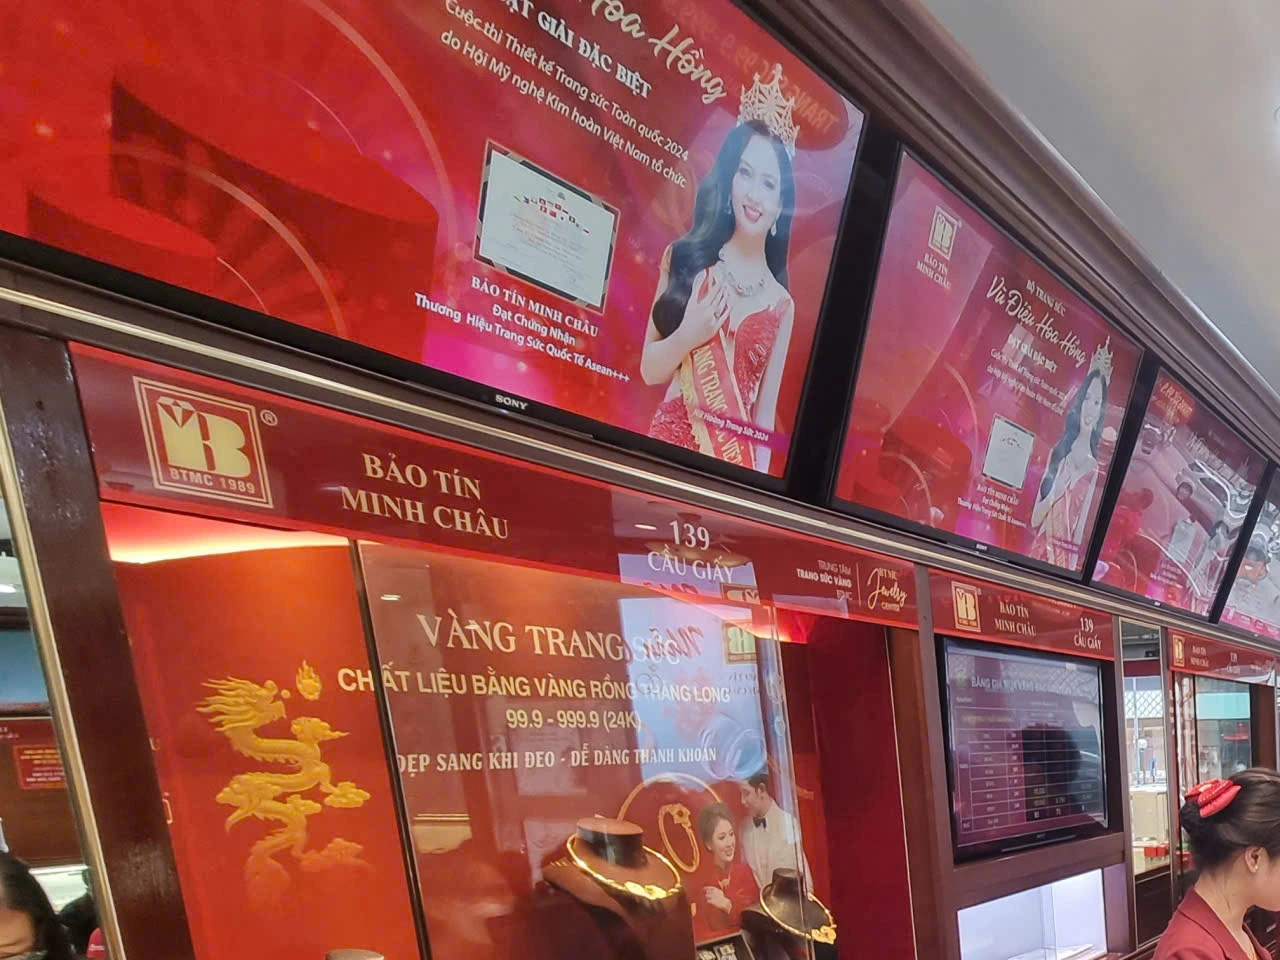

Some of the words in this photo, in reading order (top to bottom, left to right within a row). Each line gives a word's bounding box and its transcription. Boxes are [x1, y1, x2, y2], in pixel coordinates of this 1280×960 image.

[577, 37, 613, 72] ĐẶC
[615, 63, 653, 99] BIỆT
[591, 0, 645, 39] oa
[648, 23, 728, 105] Hồng
[440, 30, 461, 50] do
[462, 40, 489, 68] Hội
[488, 57, 512, 82] Mỹ
[511, 74, 545, 105] nghệ
[546, 90, 570, 117] Kim
[570, 106, 601, 136] hoàn
[602, 126, 624, 151] Việt
[624, 142, 650, 167] Nam
[651, 158, 664, 174] tổ
[662, 166, 688, 188] chức
[483, 21, 504, 44] thi
[505, 33, 538, 66] Thiết
[538, 54, 555, 76] kế
[556, 65, 589, 101] Trang
[589, 90, 610, 112] sức
[611, 102, 637, 129] Toàn
[637, 125, 664, 147] quốc
[663, 138, 689, 161] 2024
[471, 275, 500, 298] BẢO
[502, 287, 526, 308] TÍN
[528, 300, 563, 323] MINH
[564, 313, 600, 338] CHÂU
[491, 303, 513, 322] Đạt
[513, 312, 549, 336] Chứng
[549, 326, 577, 346] Nhận
[414, 291, 462, 324] Thương
[465, 312, 493, 333] Hiệu
[493, 322, 526, 346] Trang
[525, 335, 545, 351] Sức
[545, 343, 572, 363] Quốc
[572, 351, 585, 366] Tế
[1036, 312, 1060, 345] Hoa
[494, 393, 529, 410] SONY
[725, 420, 743, 434] Trang
[754, 431, 769, 442] 2024
[169, 467, 214, 487] BTMC
[219, 477, 256, 495] 1989
[361, 452, 428, 489] BẢO
[433, 465, 481, 501] TÍN
[341, 485, 426, 526] MINH
[433, 501, 509, 540] CHÂU
[668, 520, 711, 551] 139
[647, 543, 687, 577] CẦU
[692, 555, 735, 585] GIẤY
[796, 568, 819, 581] TRANG
[834, 575, 853, 588] VÀNG
[995, 620, 1015, 635] MINH
[999, 601, 1016, 617] BẢO
[1017, 604, 1030, 618] TÍN
[1079, 617, 1094, 632] 139
[416, 608, 517, 653] VÀNG
[524, 625, 628, 662] TRANG
[416, 667, 468, 699] LIỆU
[471, 665, 532, 697] BẰNG
[533, 672, 587, 699] VÀNG
[591, 672, 638, 700] RỒNG
[694, 686, 731, 703] LONG
[506, 708, 544, 730] 99.9
[556, 708, 600, 730] 999.9
[603, 710, 642, 733] (24K)
[436, 752, 483, 772] SANG
[488, 751, 519, 769] KHI
[524, 750, 556, 768] ĐEO
[571, 742, 589, 767] DỄ
[593, 745, 630, 766] DÀNG
[634, 748, 674, 764] THANH
